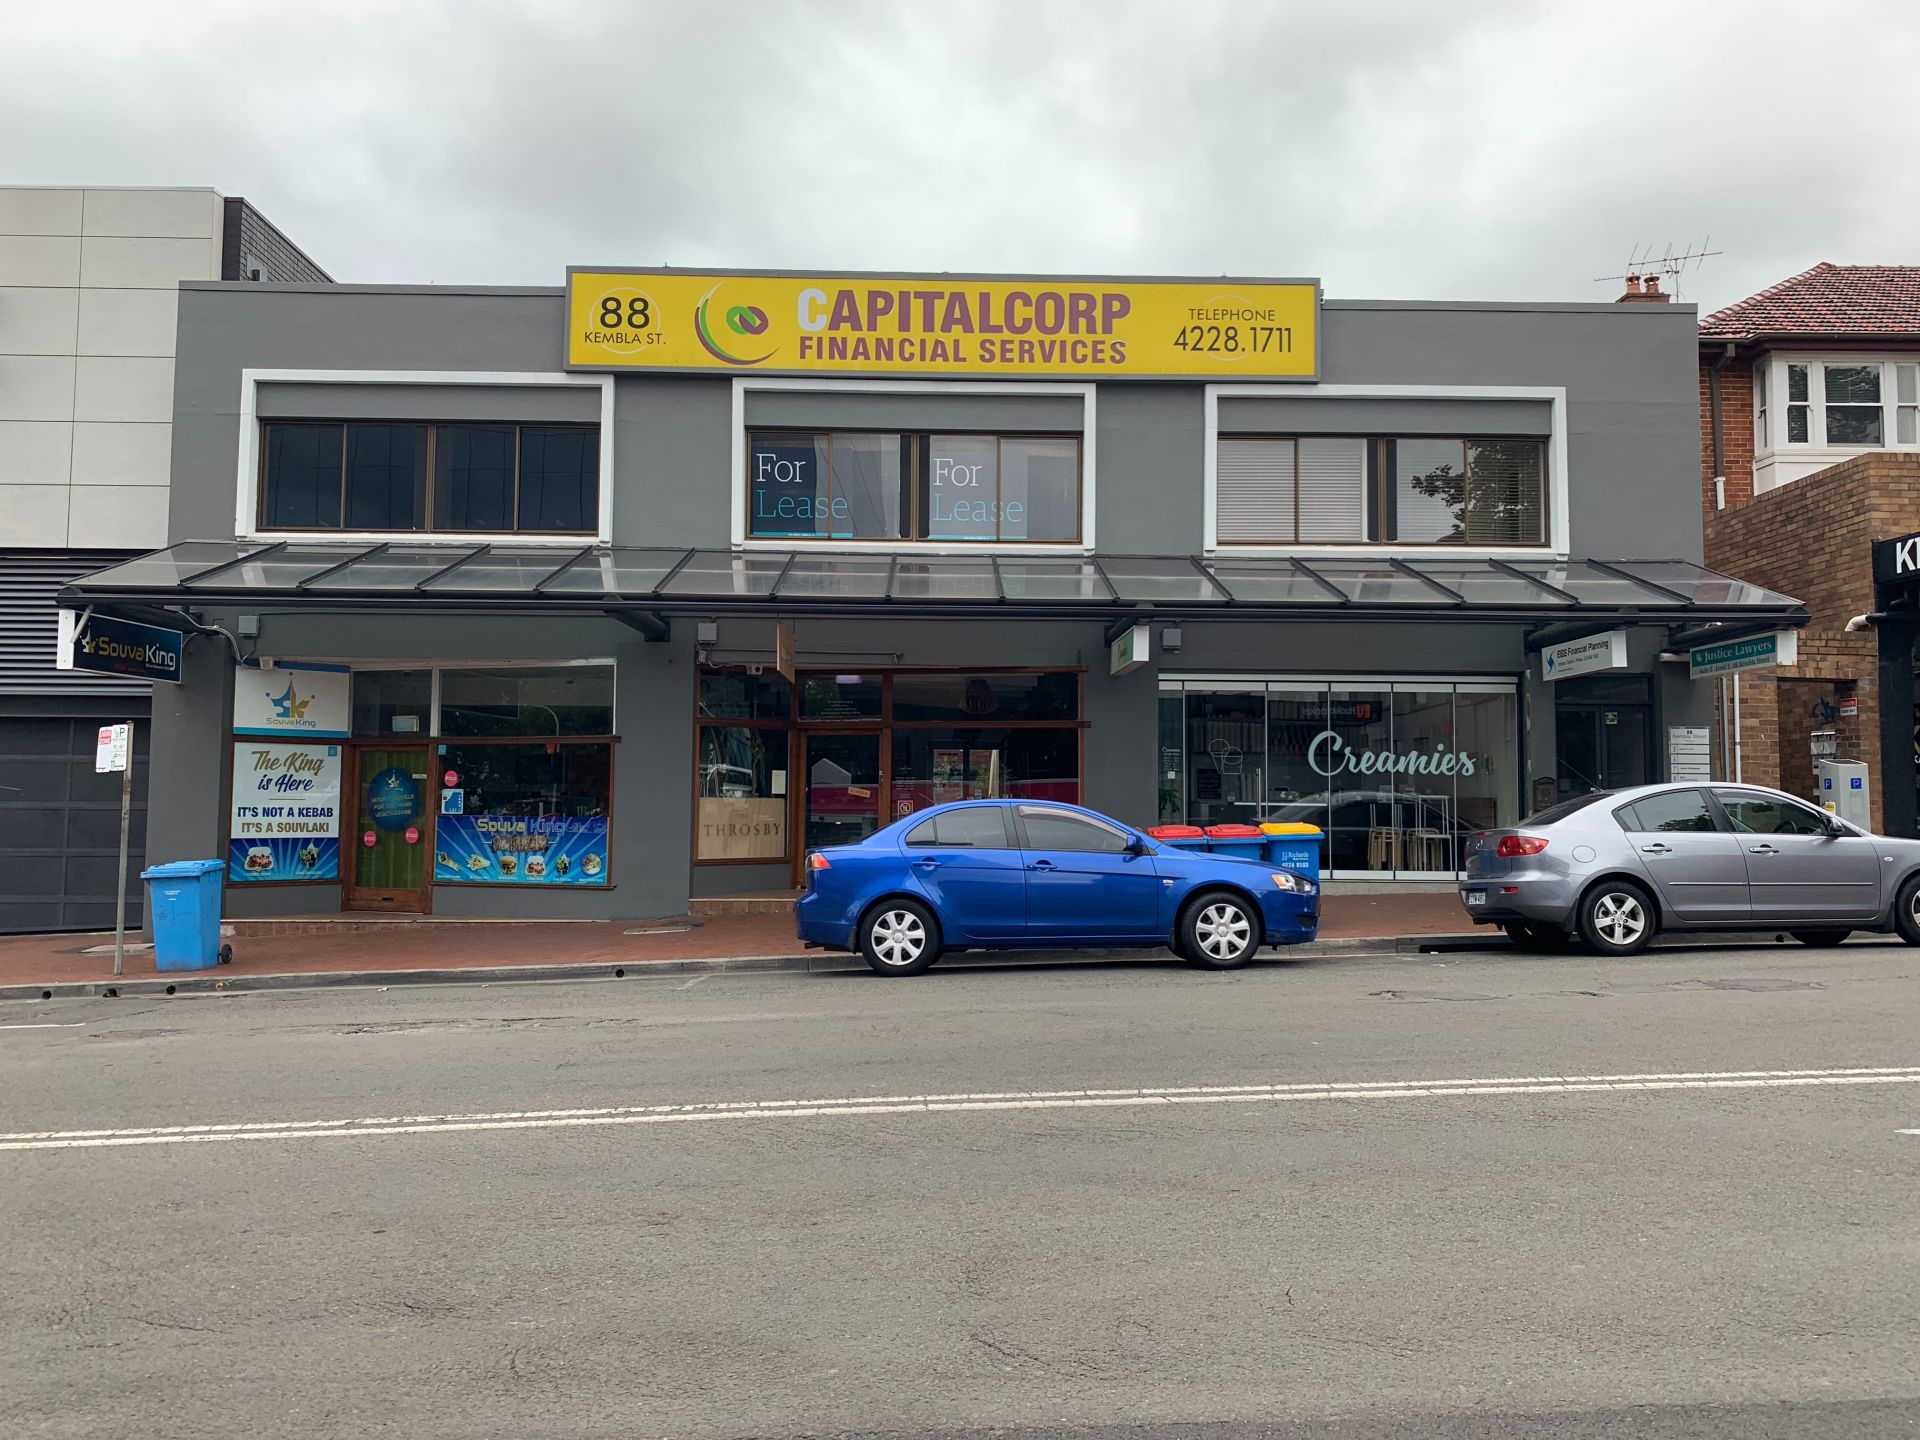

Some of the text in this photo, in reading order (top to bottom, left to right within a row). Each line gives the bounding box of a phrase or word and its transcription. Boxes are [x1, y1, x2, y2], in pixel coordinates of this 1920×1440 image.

[600, 296, 650, 329] 88
[797, 288, 1131, 335] CAPITALCORP
[1188, 308, 1276, 322] TELEPHONE
[584, 331, 667, 345] KEMBLA ST.
[799, 336, 1126, 364] FINANCIAL SERVICES
[1173, 325, 1292, 353] 4228.1711
[755, 453, 806, 483] For
[932, 457, 983, 487] For
[755, 489, 848, 519] Lease
[932, 493, 1023, 522] Lease
[1568, 644, 1587, 656] Financial
[1588, 640, 1608, 652] Planning
[1705, 640, 1772, 662] Justice Lawyers
[251, 750, 324, 776] The King
[1307, 730, 1476, 777] Creamies
[257, 773, 314, 792] is Here
[237, 807, 333, 818] IT'S NOT A KEBAB
[241, 823, 329, 833] IT'S A SOUVLAKI
[477, 817, 567, 837] Souva King
[703, 823, 781, 837] THROSBY
